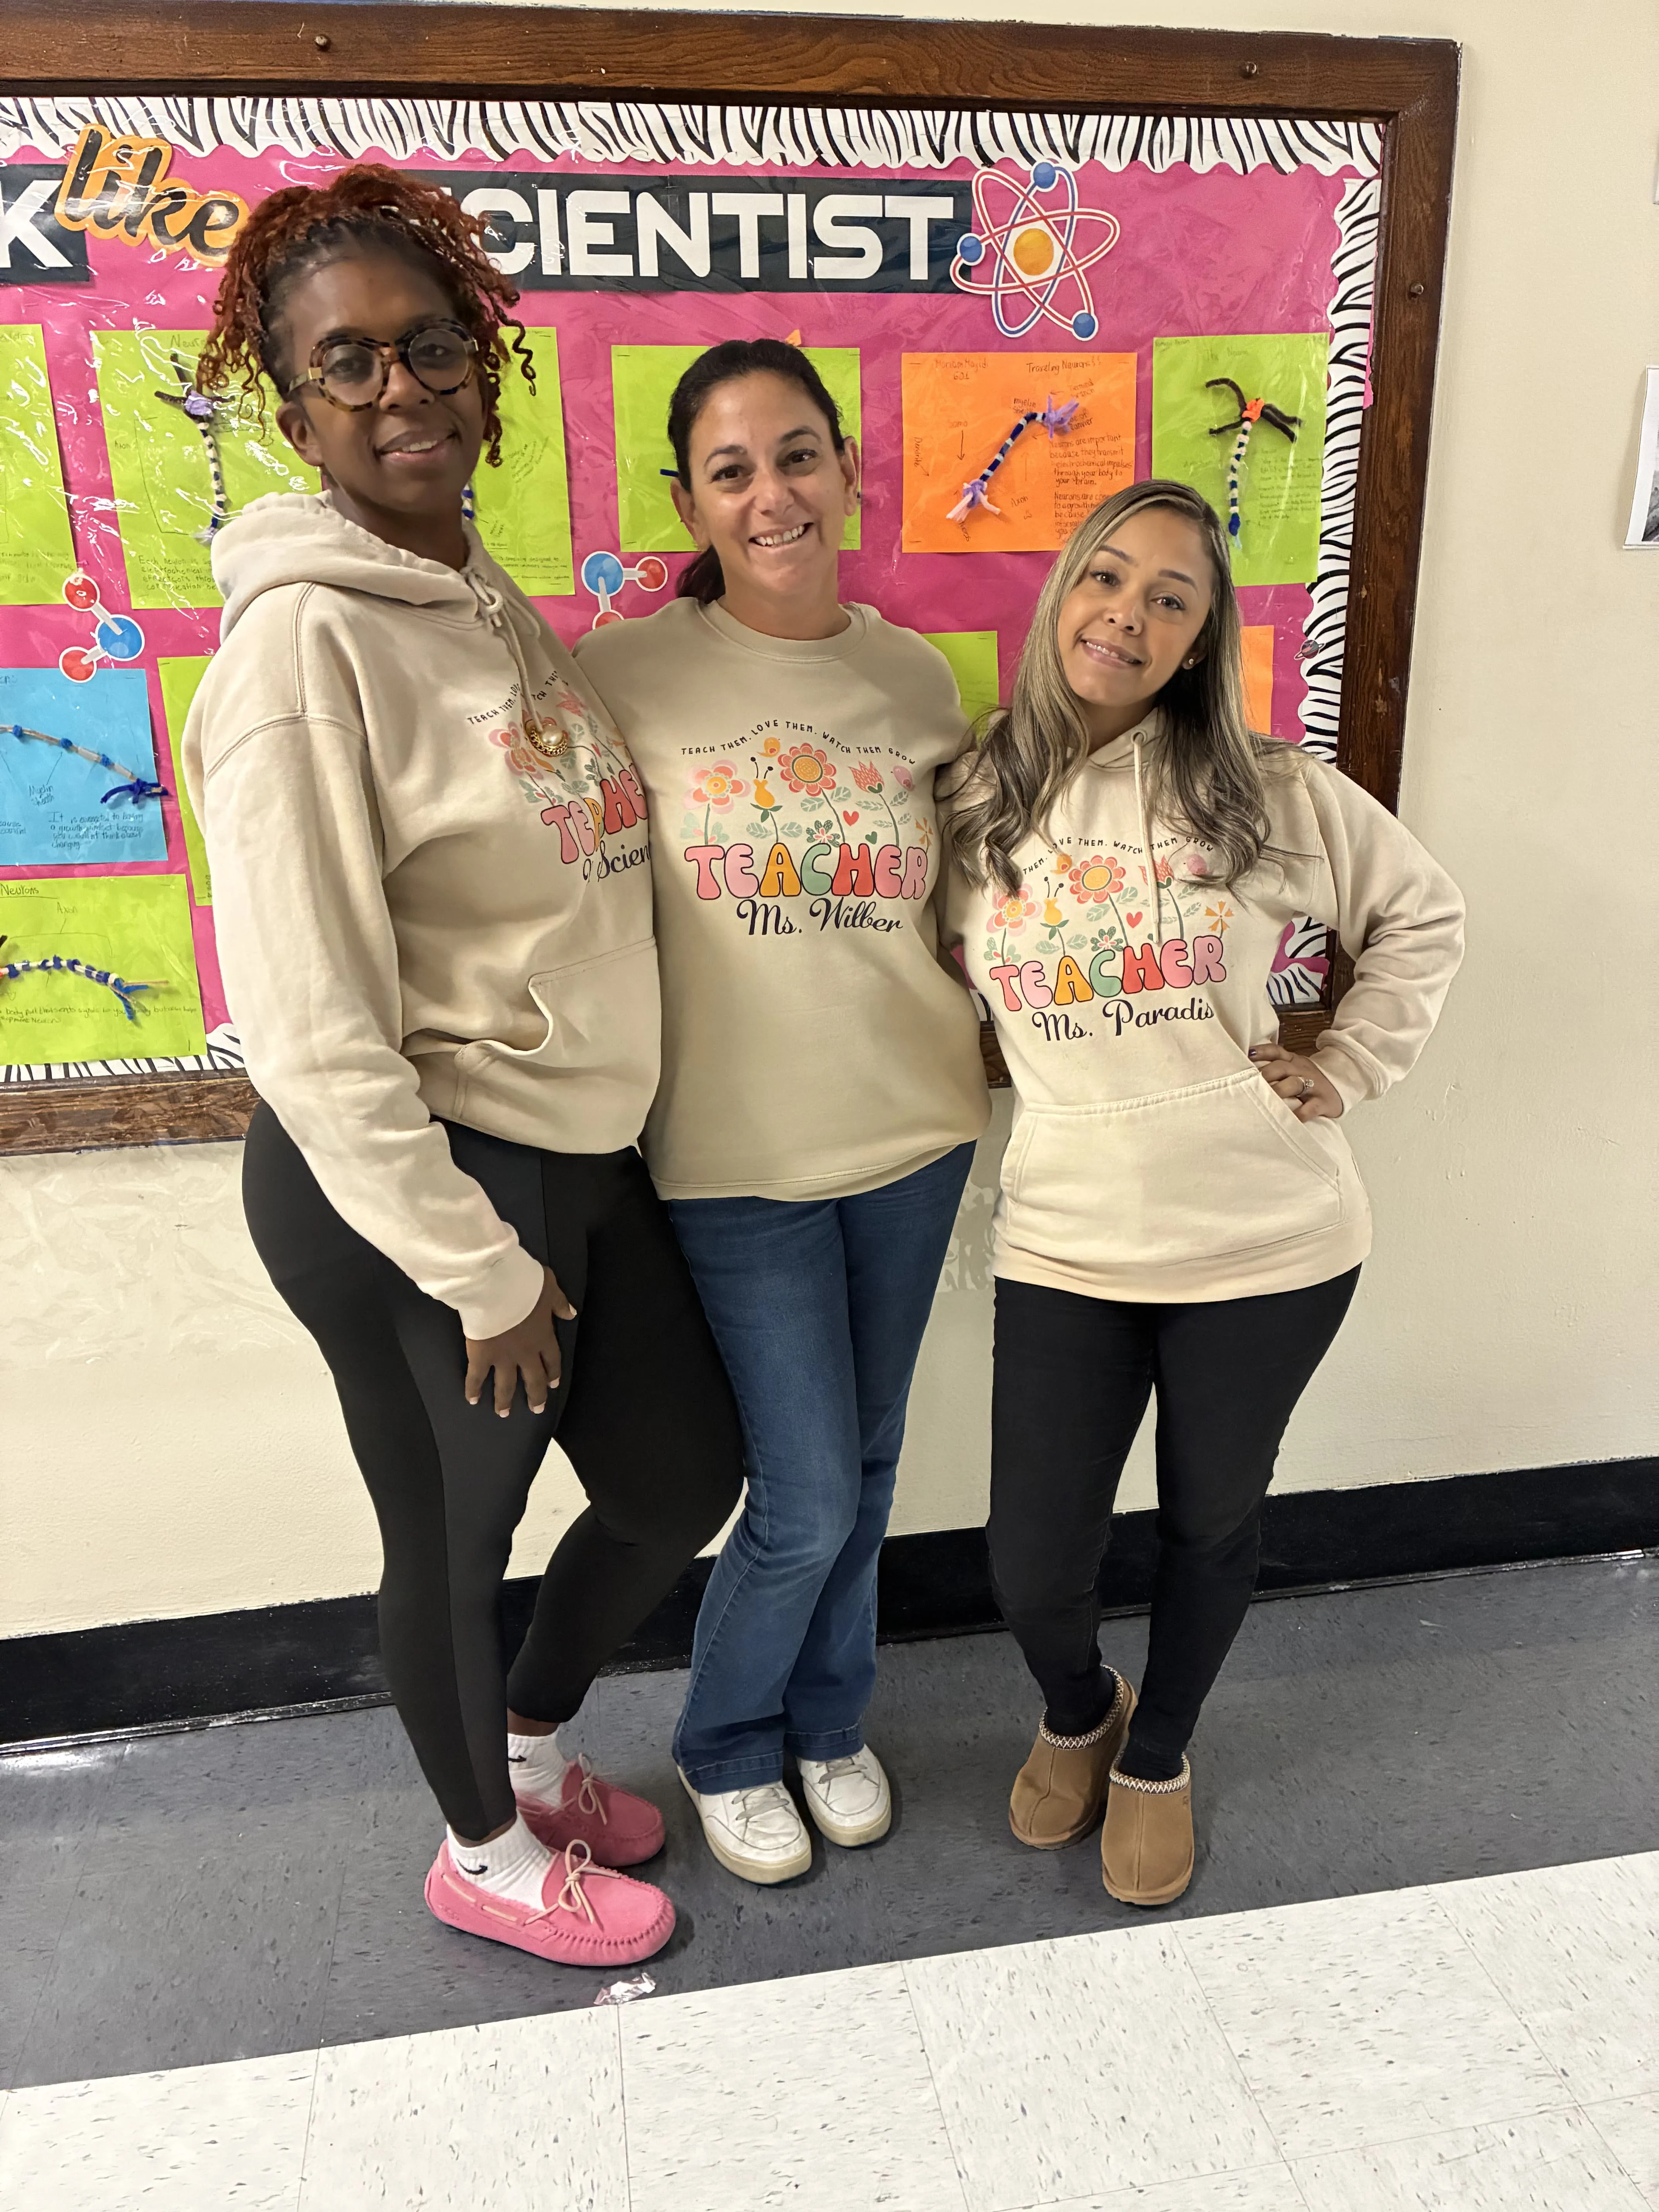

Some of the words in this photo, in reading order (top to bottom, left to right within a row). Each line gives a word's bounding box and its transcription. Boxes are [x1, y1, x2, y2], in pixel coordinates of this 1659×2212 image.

[64, 129, 239, 256] like
[440, 187, 953, 280] CIENTIST
[467, 709, 500, 725] TEACH
[531, 690, 547, 701] TCH
[681, 745, 715, 755] TEACH
[720, 736, 752, 751] THEM.
[751, 720, 778, 735] LOVE
[785, 721, 817, 735] THEM.
[822, 731, 851, 754] WATCH
[888, 747, 915, 765] GROW
[541, 761, 649, 864] TEAHE
[597, 840, 650, 882] Scien
[684, 843, 928, 900] TEACHER
[1023, 857, 1048, 875] THEM.
[1078, 838, 1108, 847] THEM.
[1113, 840, 1143, 854] WATCH
[1149, 837, 1178, 850] THEM
[1186, 836, 1214, 852] GROW
[736, 899, 803, 935] Ms.
[809, 896, 903, 933] Wilber
[989, 934, 1226, 1012] TEACHER
[1032, 1011, 1094, 1042] Ms.
[1102, 997, 1215, 1036] Paradis
